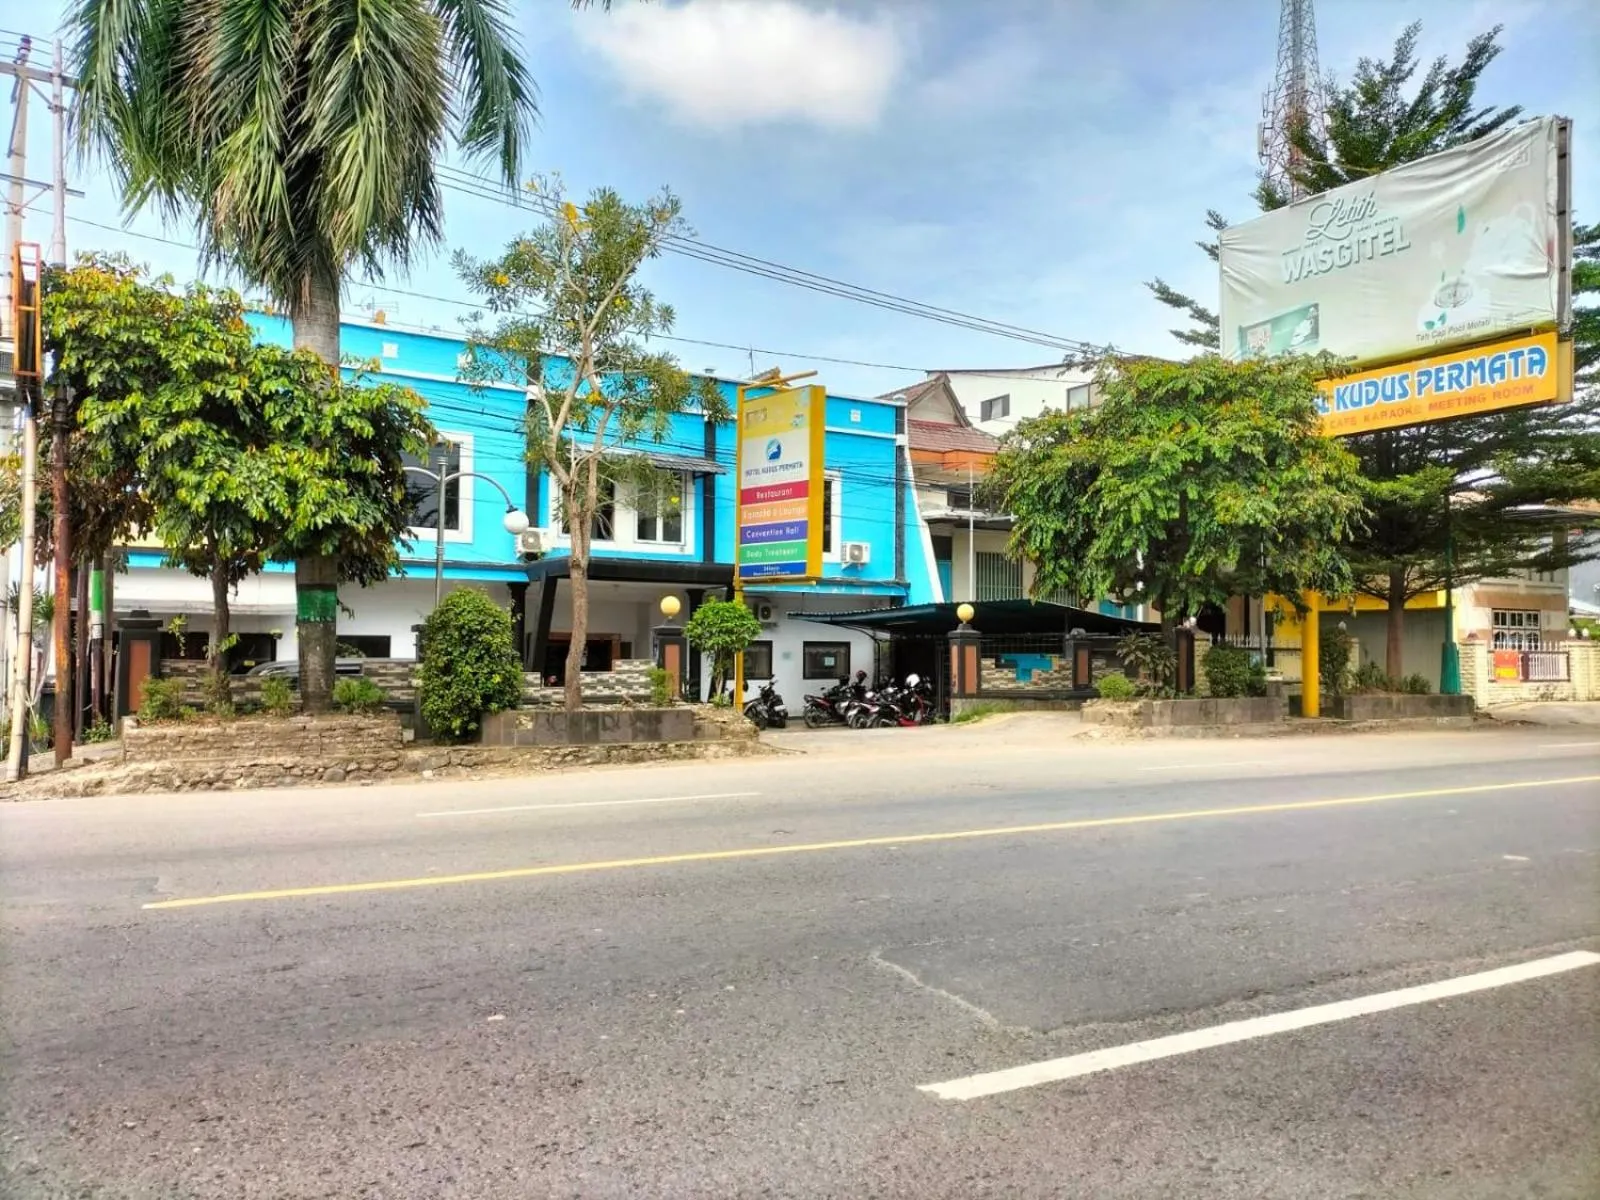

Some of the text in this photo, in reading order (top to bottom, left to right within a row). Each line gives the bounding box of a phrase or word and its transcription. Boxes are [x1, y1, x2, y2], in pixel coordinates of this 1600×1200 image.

[1281, 222, 1411, 284] WASGITEL
[1334, 371, 1411, 412] KUDUS
[1415, 345, 1547, 398] PERMATA
[1329, 384, 1535, 430] CAFE KARAOKE MEETING ROOM
[756, 487, 793, 500] Restaurant
[746, 528, 784, 539] Convention
